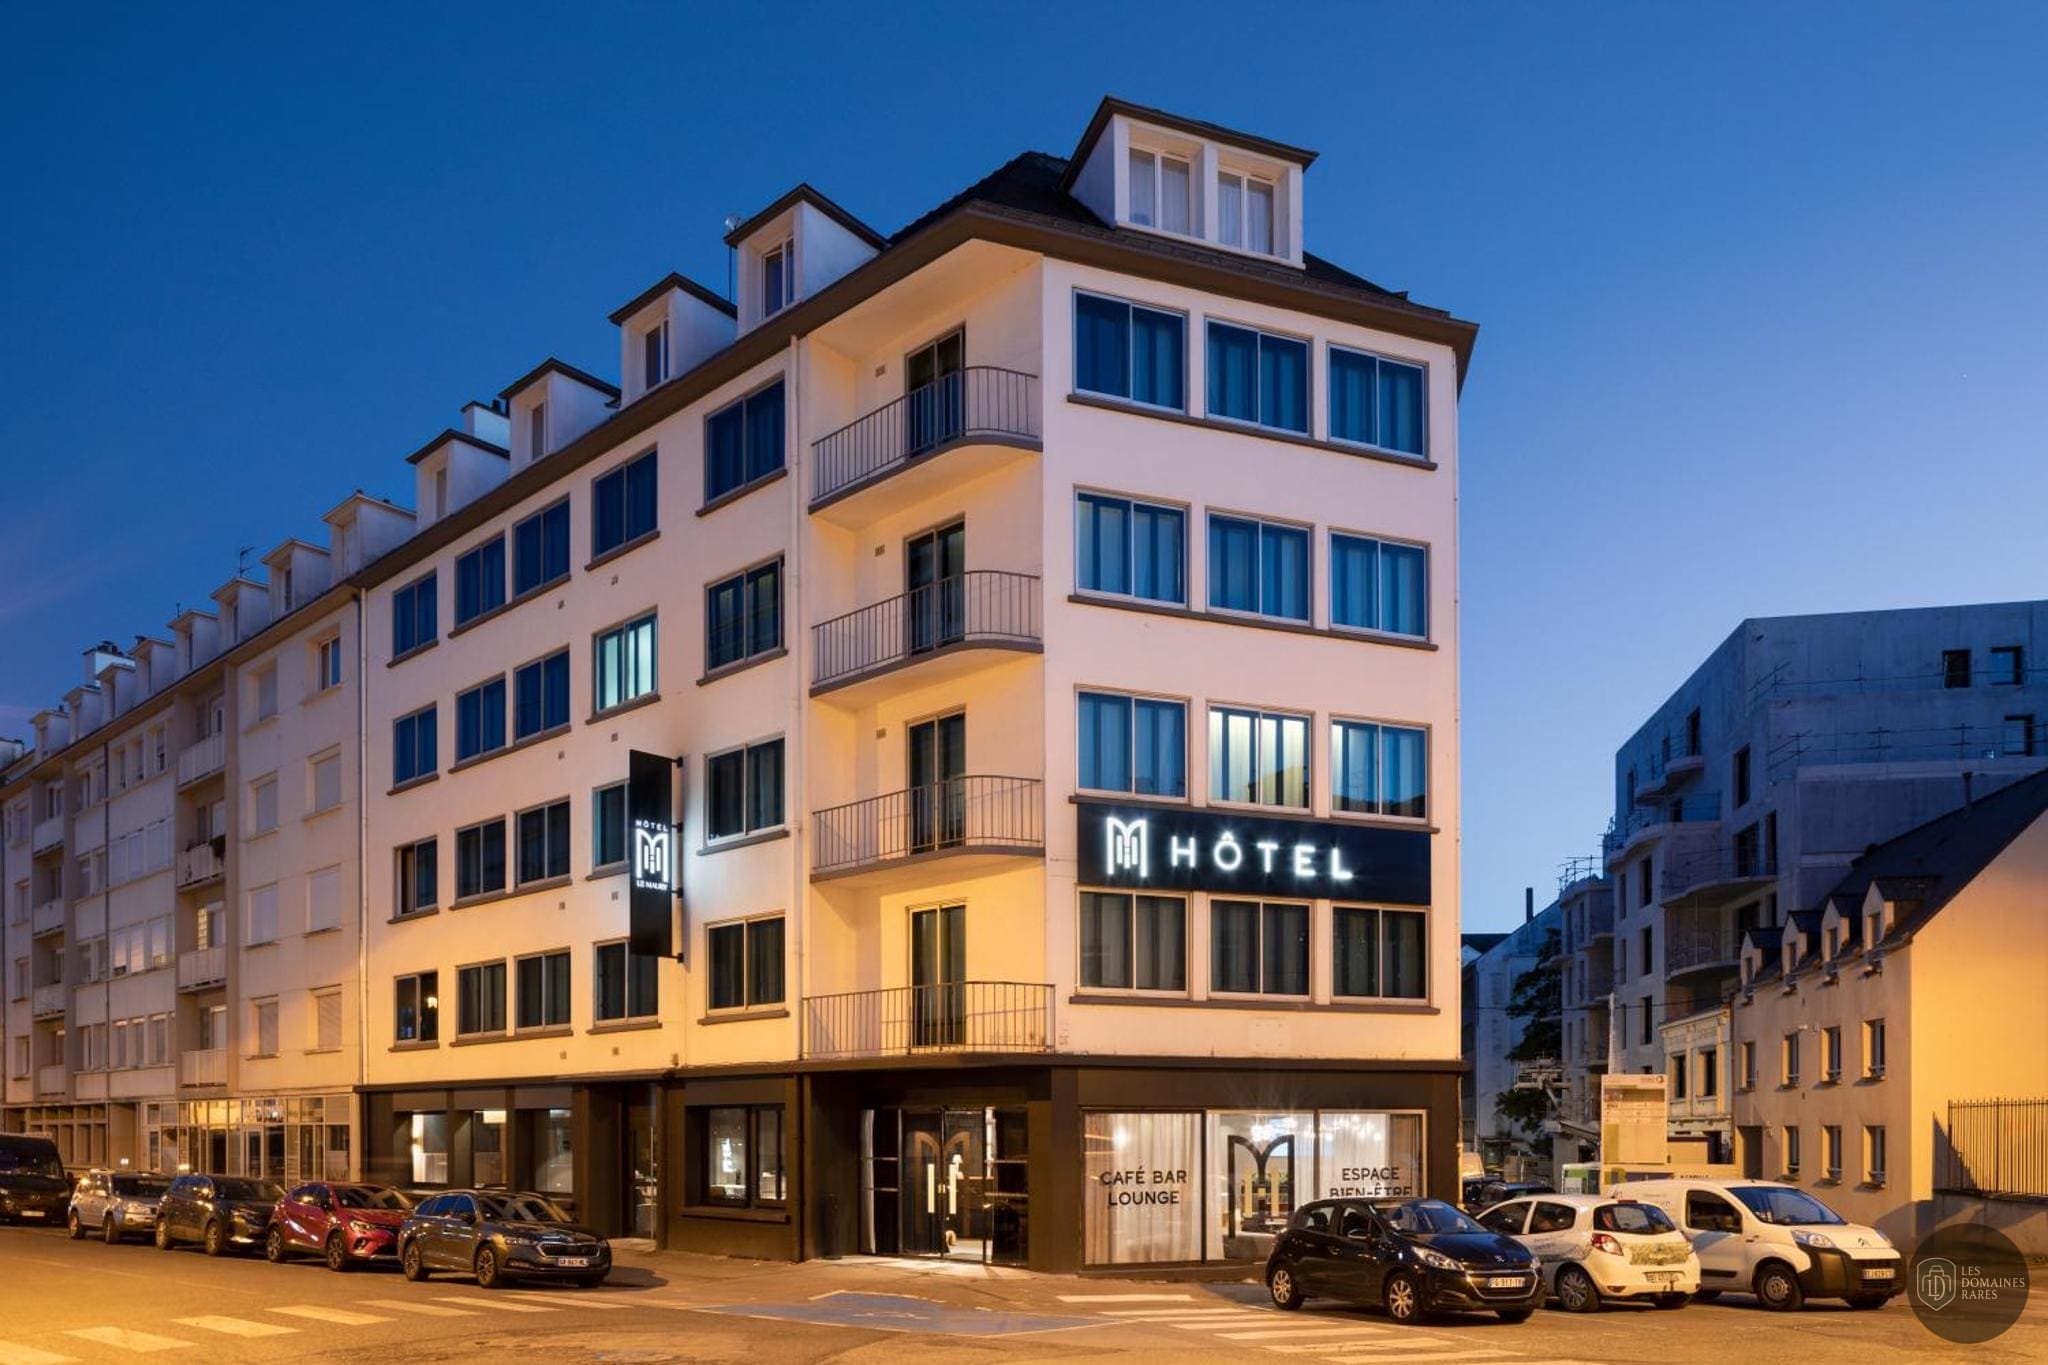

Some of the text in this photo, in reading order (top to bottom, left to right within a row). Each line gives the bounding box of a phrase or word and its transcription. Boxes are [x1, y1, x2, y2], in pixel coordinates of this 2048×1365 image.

[635, 819, 669, 832] HÔTEL
[1170, 830, 1354, 880] HÔTEL
[1099, 1165, 1187, 1186] CAFÉ BAR
[1341, 1167, 1400, 1181] ESPACE
[1108, 1190, 1180, 1206] LOUNGE
